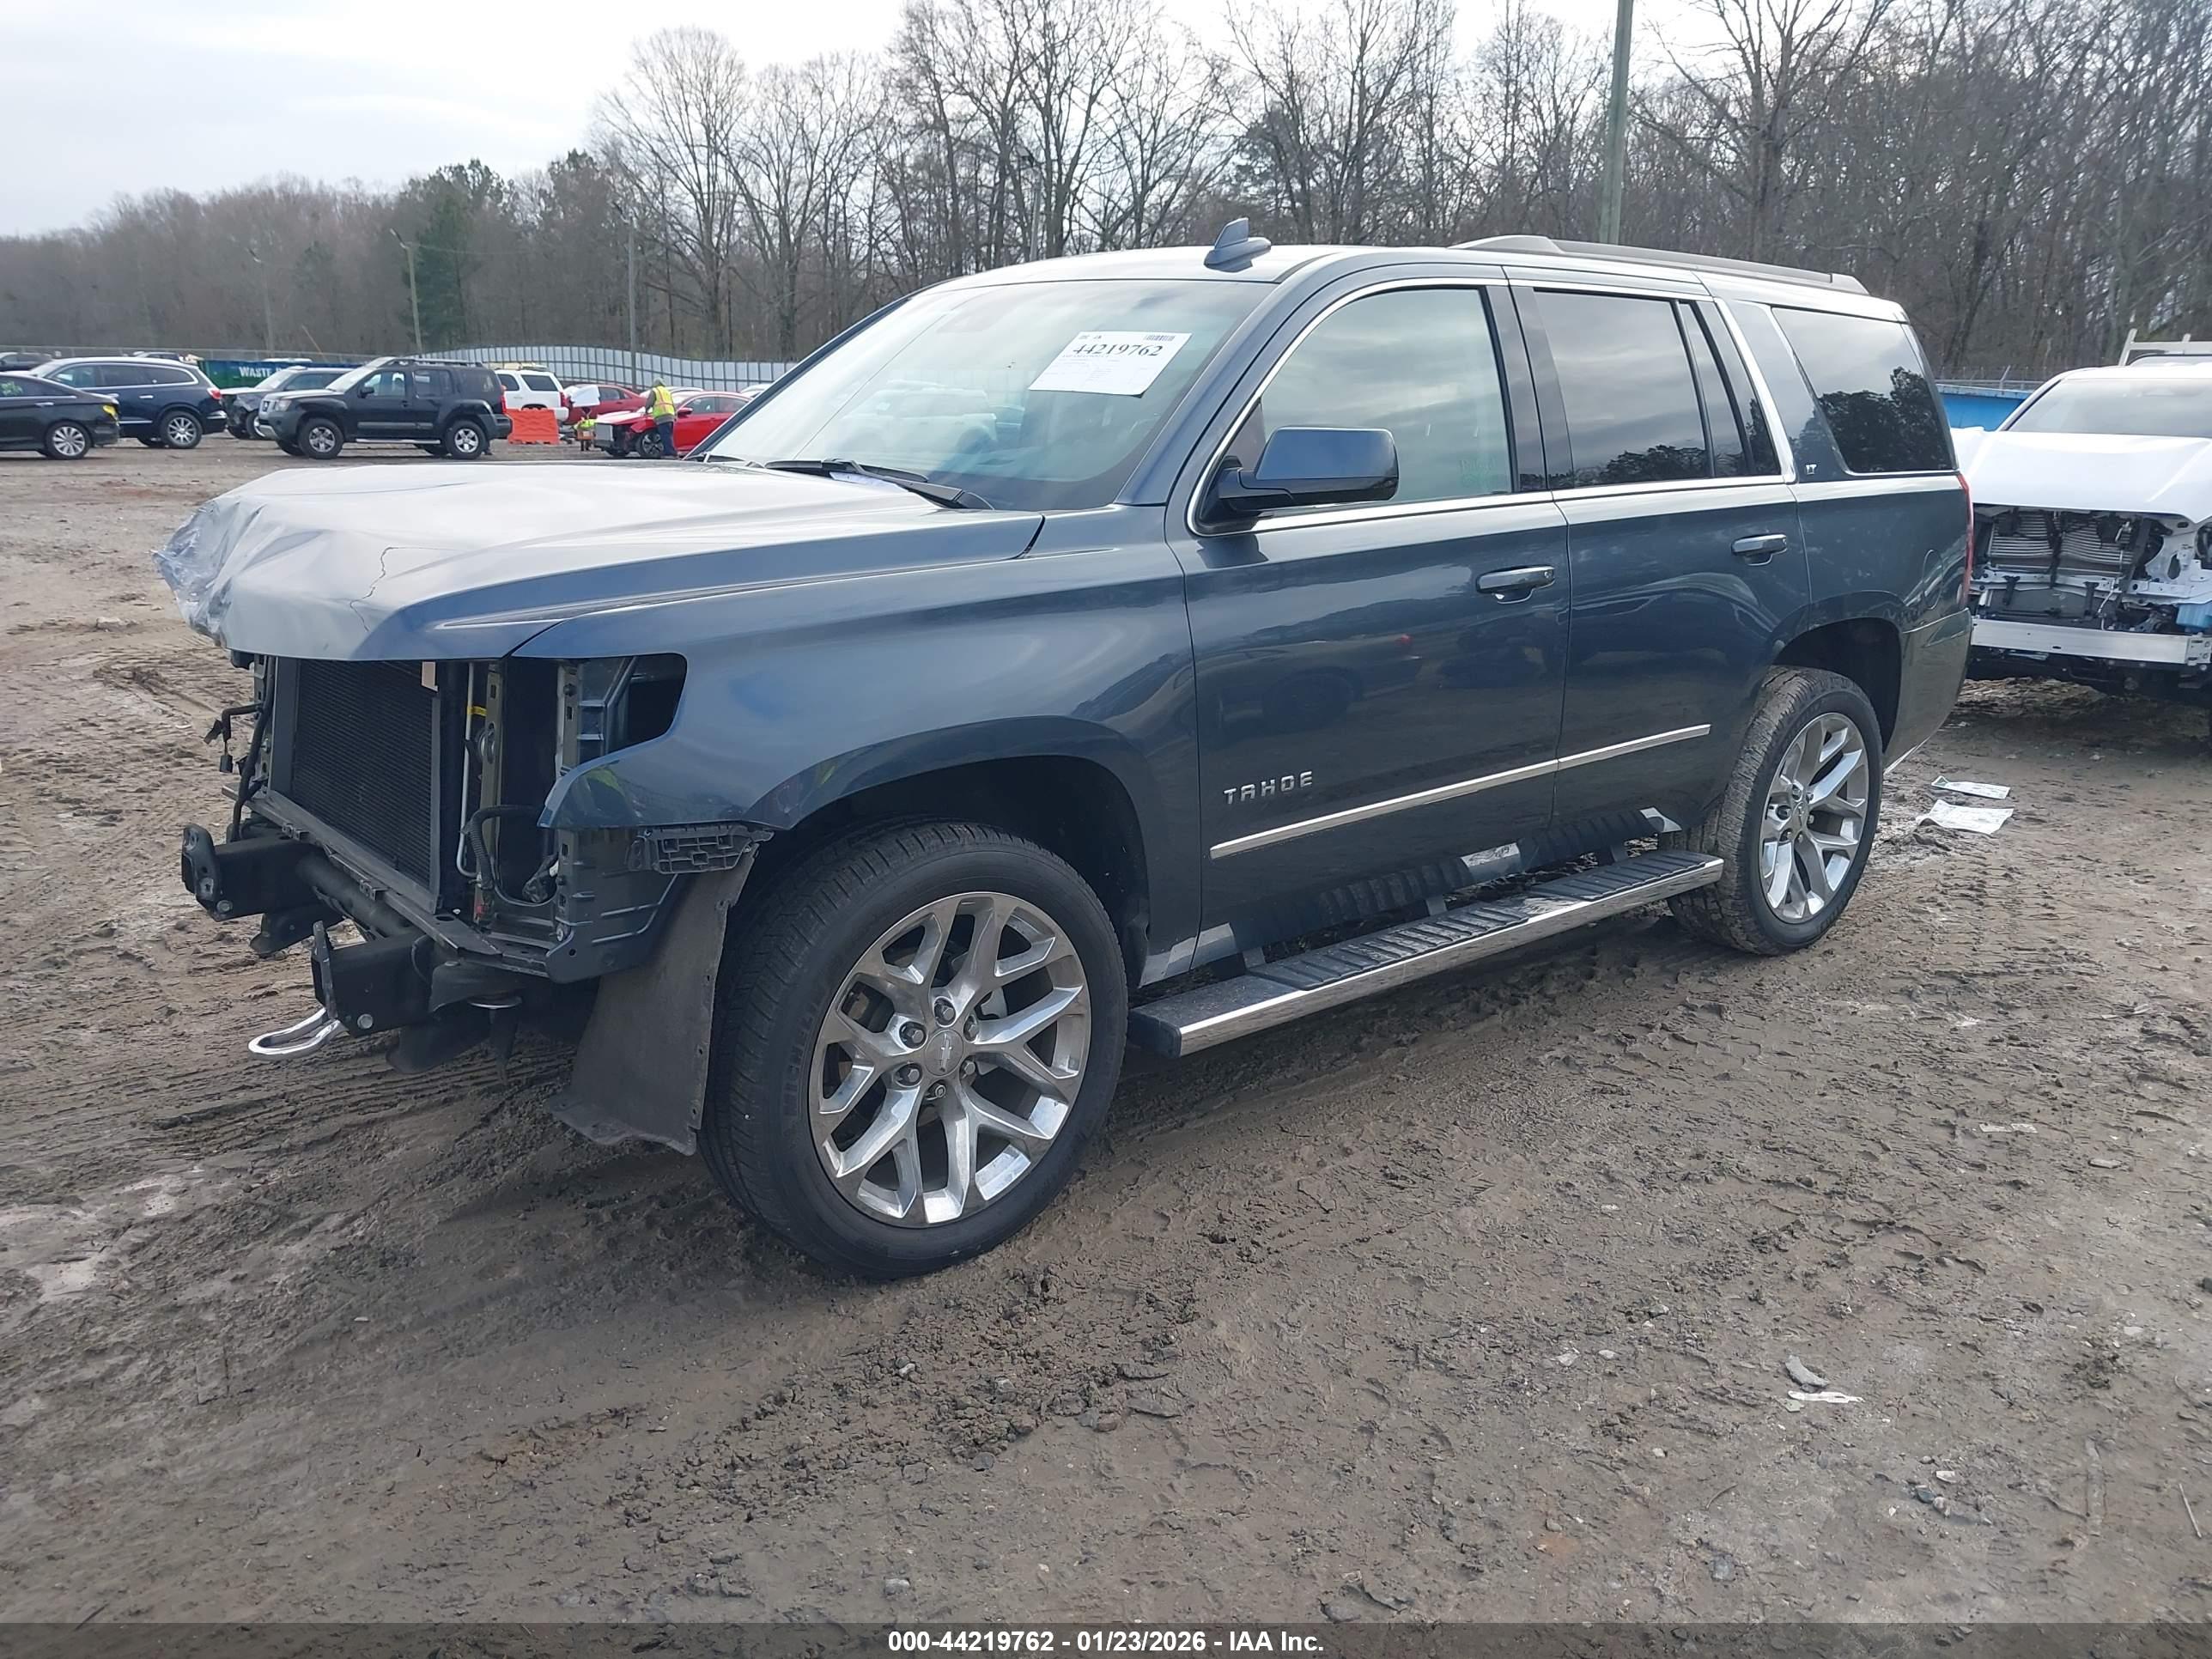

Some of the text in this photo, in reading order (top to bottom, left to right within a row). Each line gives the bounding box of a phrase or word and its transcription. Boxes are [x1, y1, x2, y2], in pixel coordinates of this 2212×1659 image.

[1073, 343, 1164, 356] 44219762
[239, 366, 272, 378] WASTE
[1223, 770, 1314, 805] TAHOE
